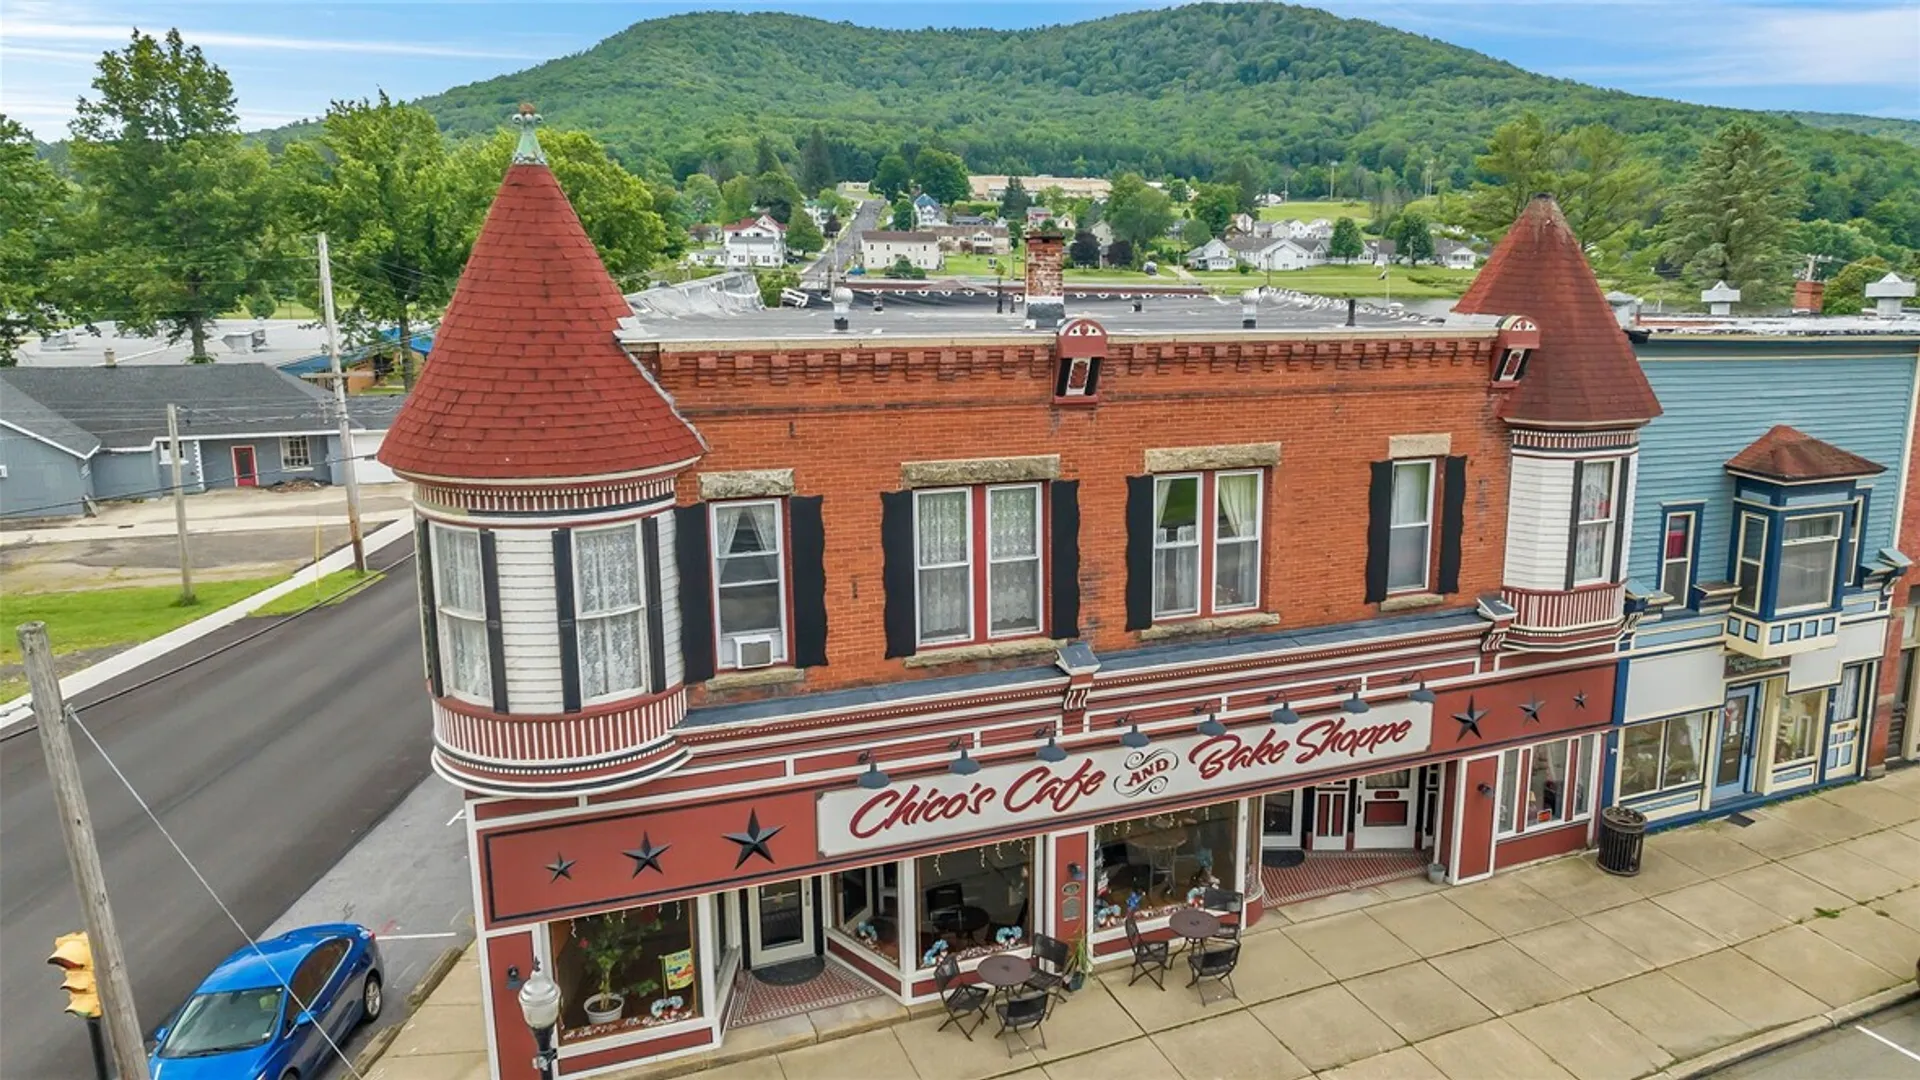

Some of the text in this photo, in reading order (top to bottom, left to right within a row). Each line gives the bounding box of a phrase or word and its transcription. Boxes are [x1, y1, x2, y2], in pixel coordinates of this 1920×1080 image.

[849, 718, 1412, 839] Chico's Cafe AND Bake Shoppe
